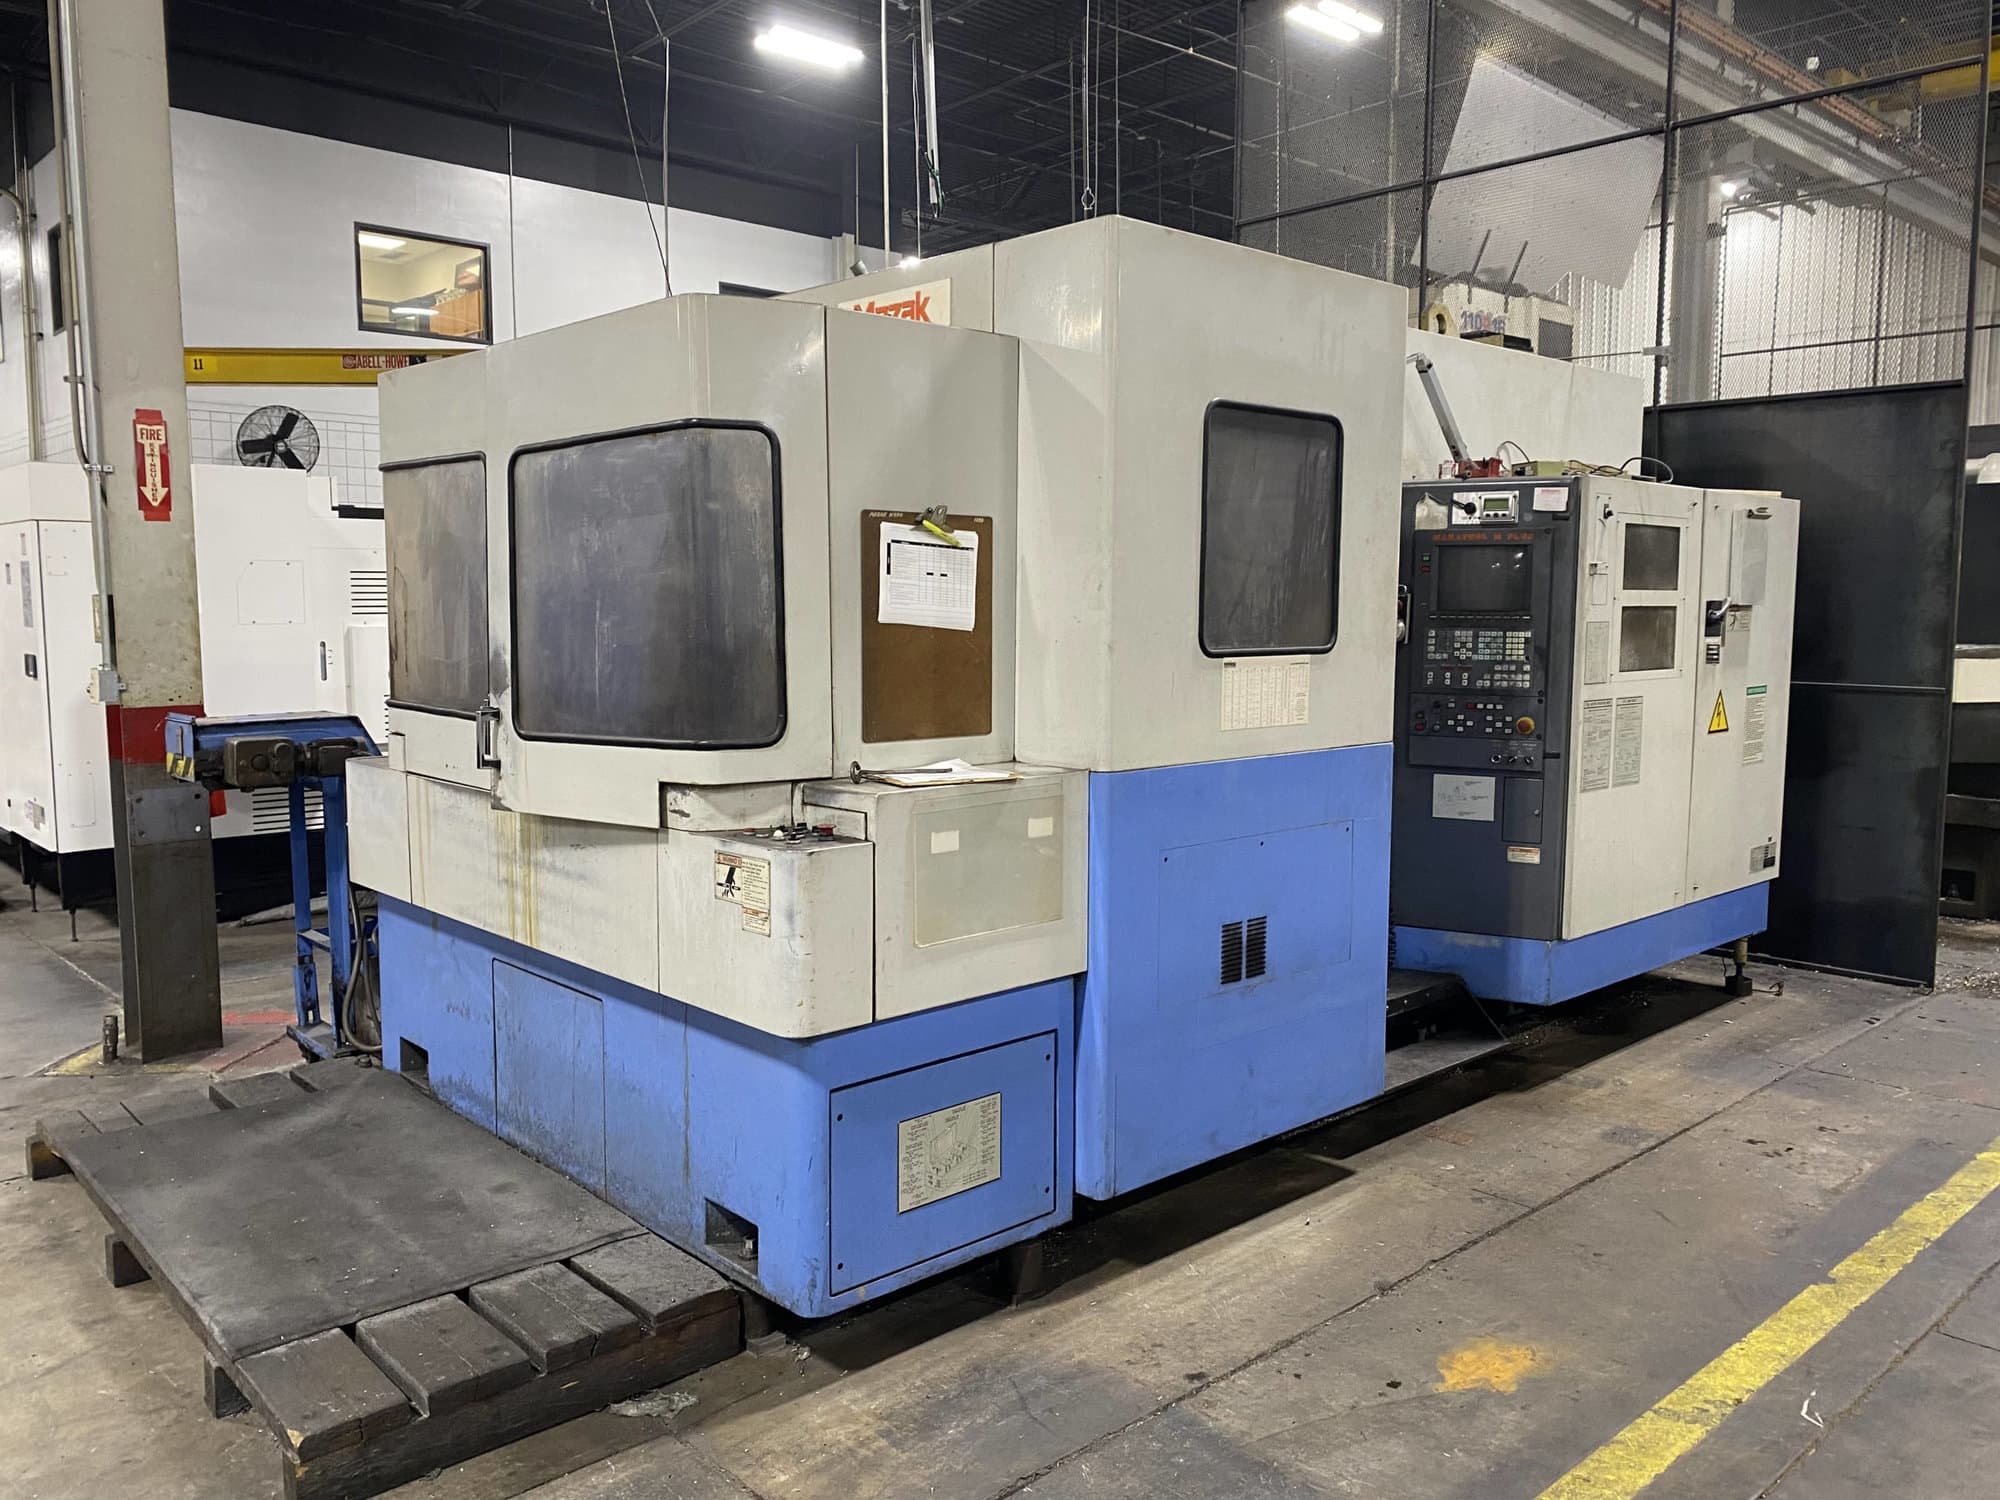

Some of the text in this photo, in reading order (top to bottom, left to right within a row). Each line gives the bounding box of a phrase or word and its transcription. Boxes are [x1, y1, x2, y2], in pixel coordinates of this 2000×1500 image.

[193, 358, 203, 370] 11
[140, 427, 162, 441] FIRE
[149, 442, 158, 502] EXTINGUISHER
